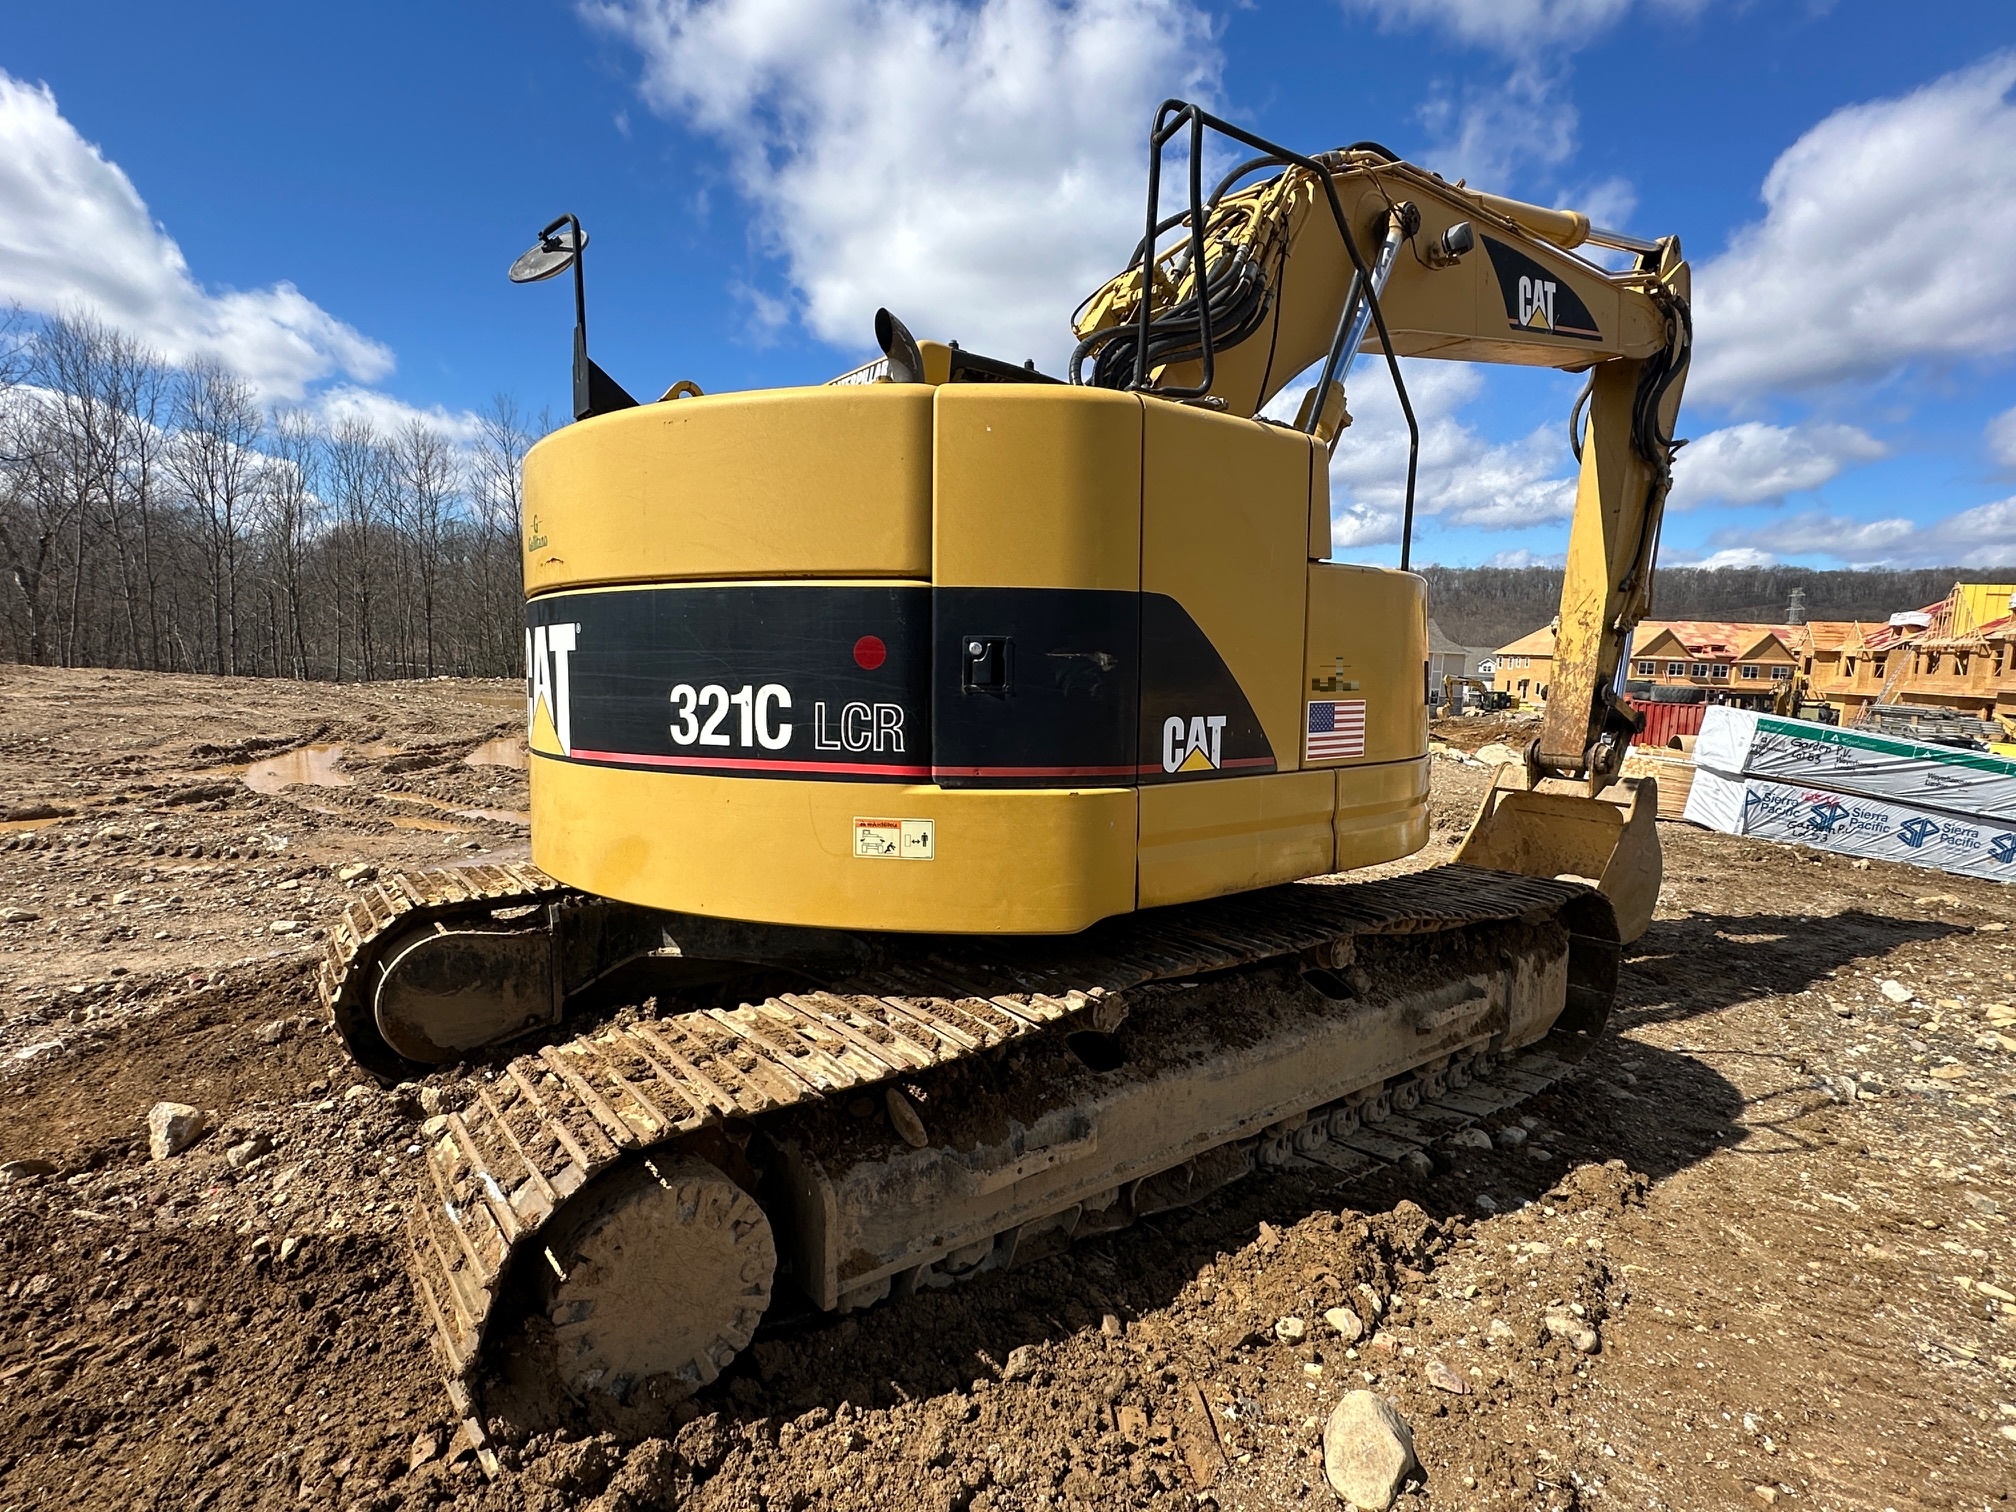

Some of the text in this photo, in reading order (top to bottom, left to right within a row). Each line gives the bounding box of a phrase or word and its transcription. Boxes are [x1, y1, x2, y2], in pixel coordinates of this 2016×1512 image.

[1518, 275, 1557, 330] CAT
[832, 360, 889, 386] TERPILLAR
[525, 622, 577, 757] CAT
[669, 683, 906, 753] 321C LCR
[1162, 714, 1227, 774] CAT
[1763, 792, 1799, 807] Sierra
[1760, 803, 1801, 818] Pacific
[1851, 807, 1890, 823] Sierra
[1849, 818, 1891, 834] Pacific
[1941, 822, 1979, 838] Sierra
[1939, 833, 1982, 849] Pacific
